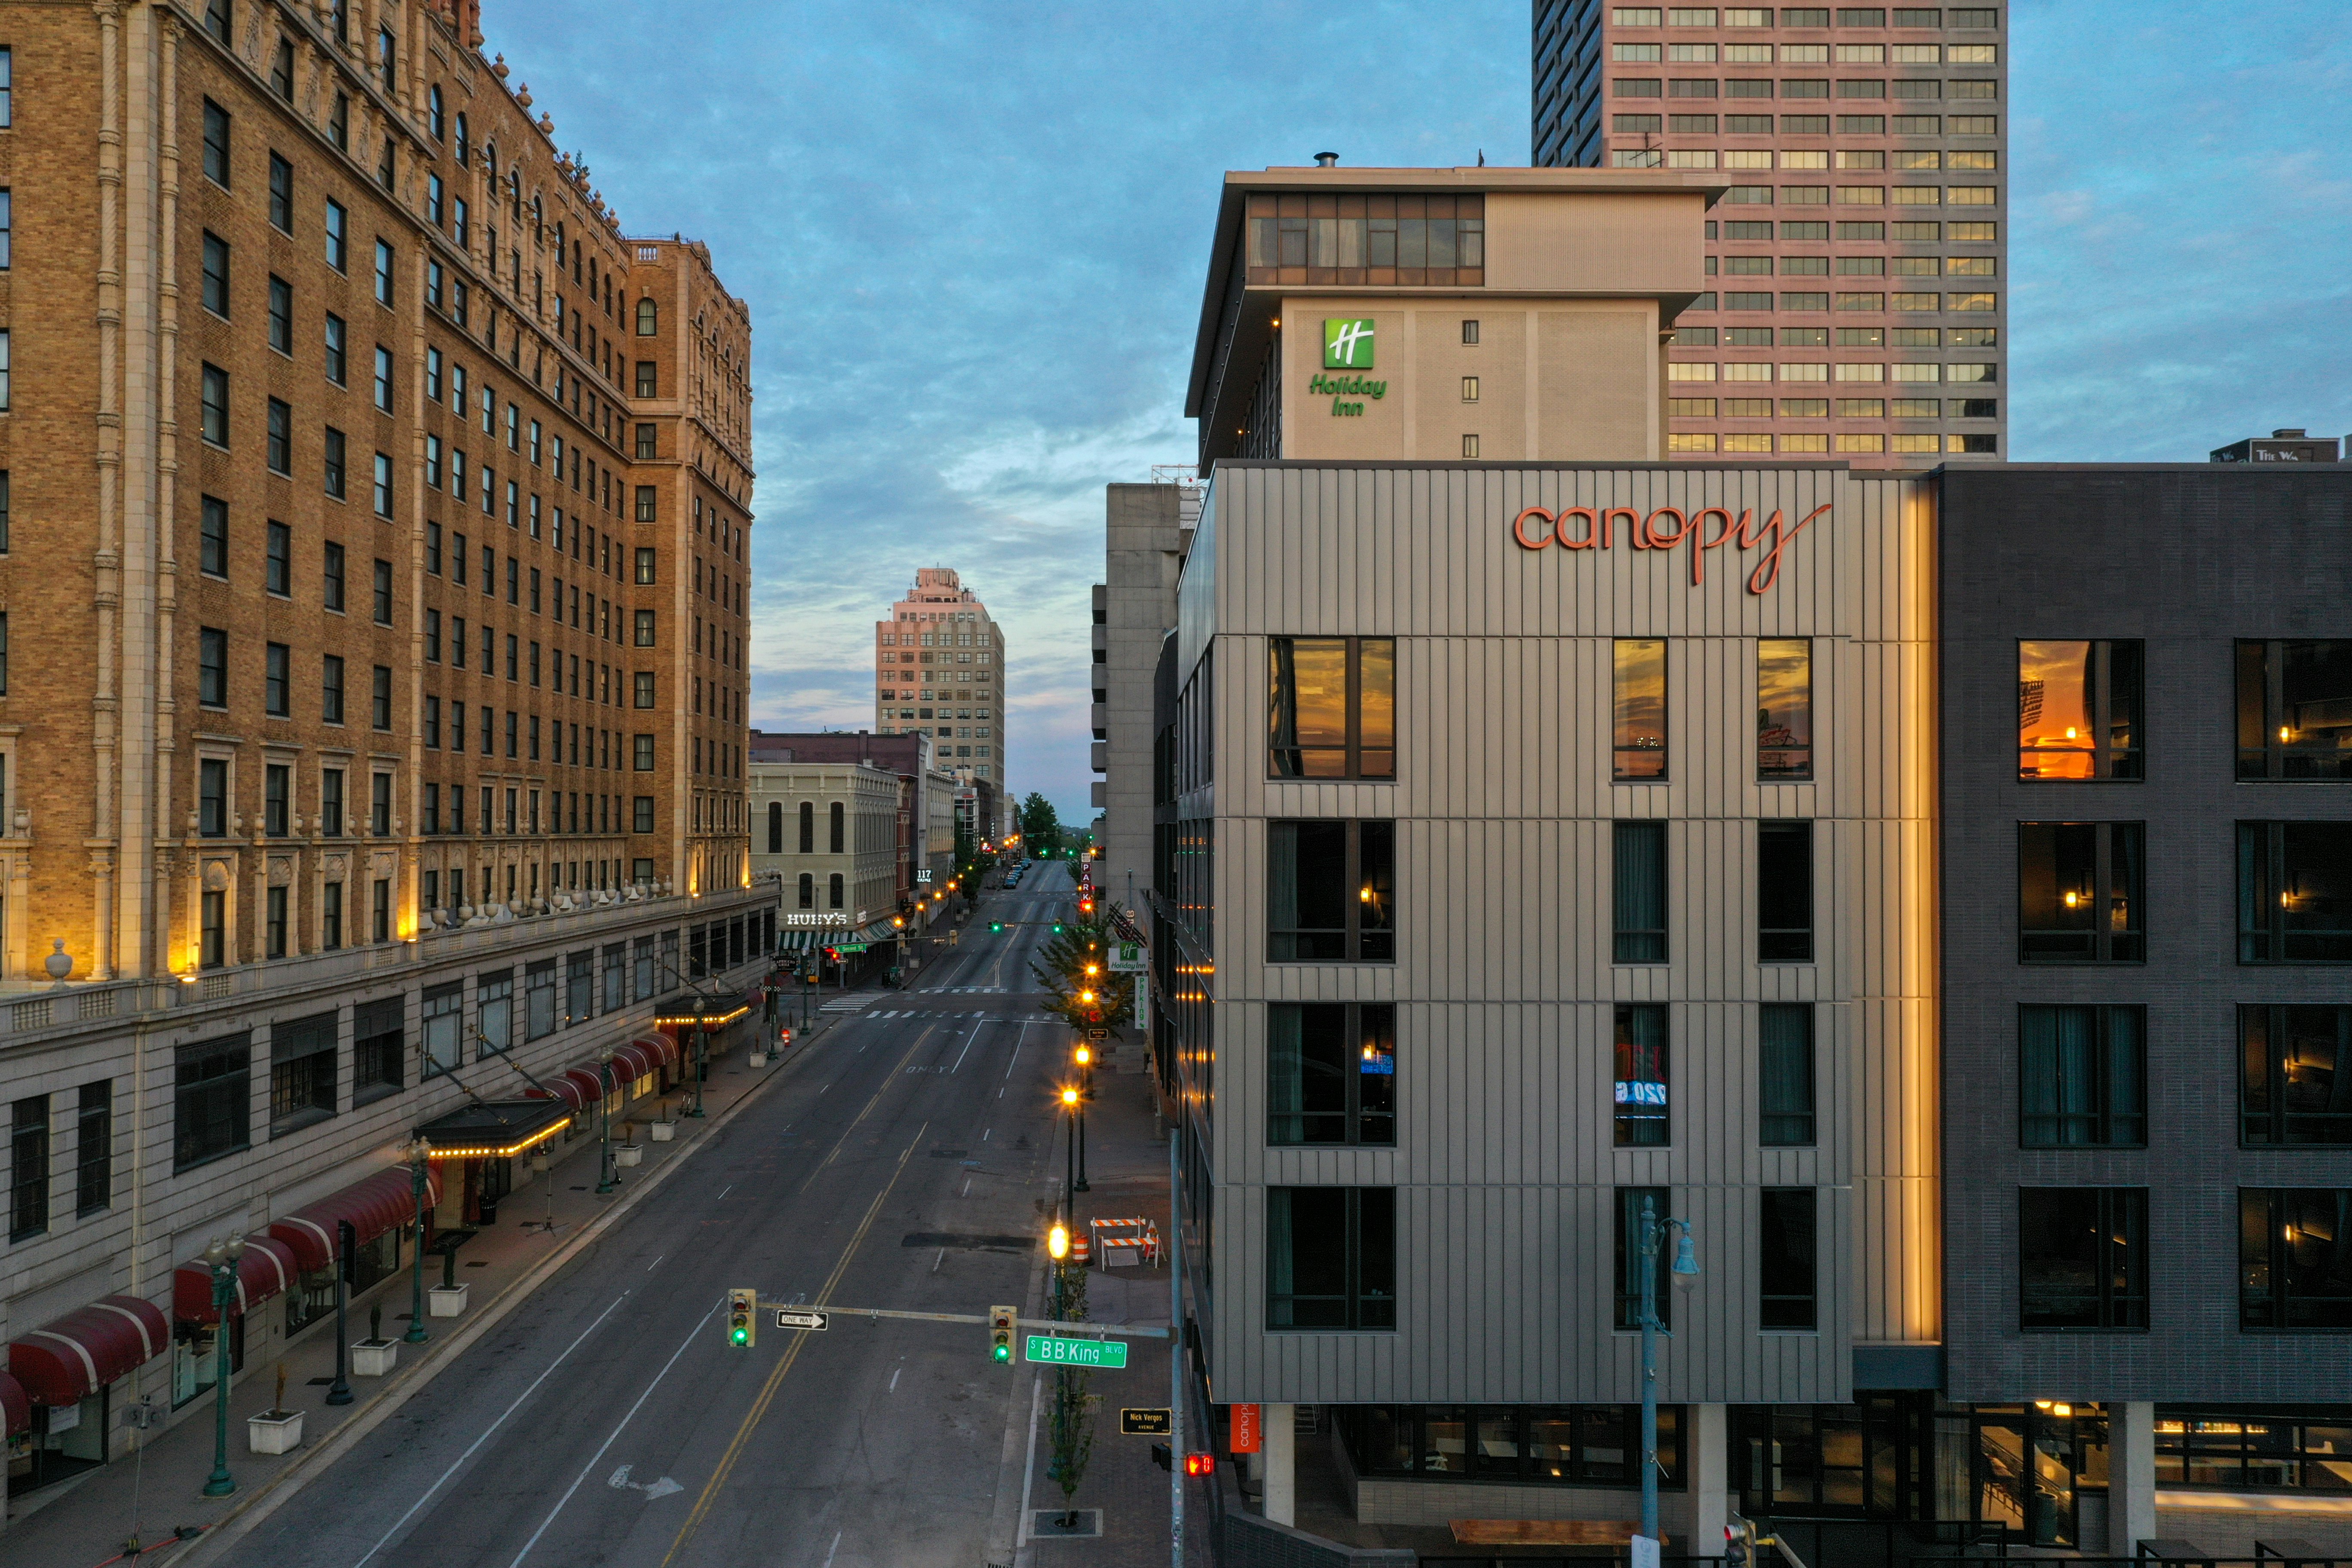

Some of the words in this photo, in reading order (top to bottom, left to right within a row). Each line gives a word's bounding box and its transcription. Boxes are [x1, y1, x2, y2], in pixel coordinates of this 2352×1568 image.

[1311, 373, 1387, 399] Holiday
[1332, 396, 1365, 416] Inn
[1515, 503, 1832, 594] canopy
[917, 870, 931, 878] 117
[787, 913, 847, 925] HUEY'S
[1112, 962, 1137, 970] Holiday
[1030, 1340, 1036, 1349] S
[1069, 1343, 1099, 1364] King
[1105, 1345, 1123, 1354] BLVD
[1144, 1413, 1163, 1423] Vergos
